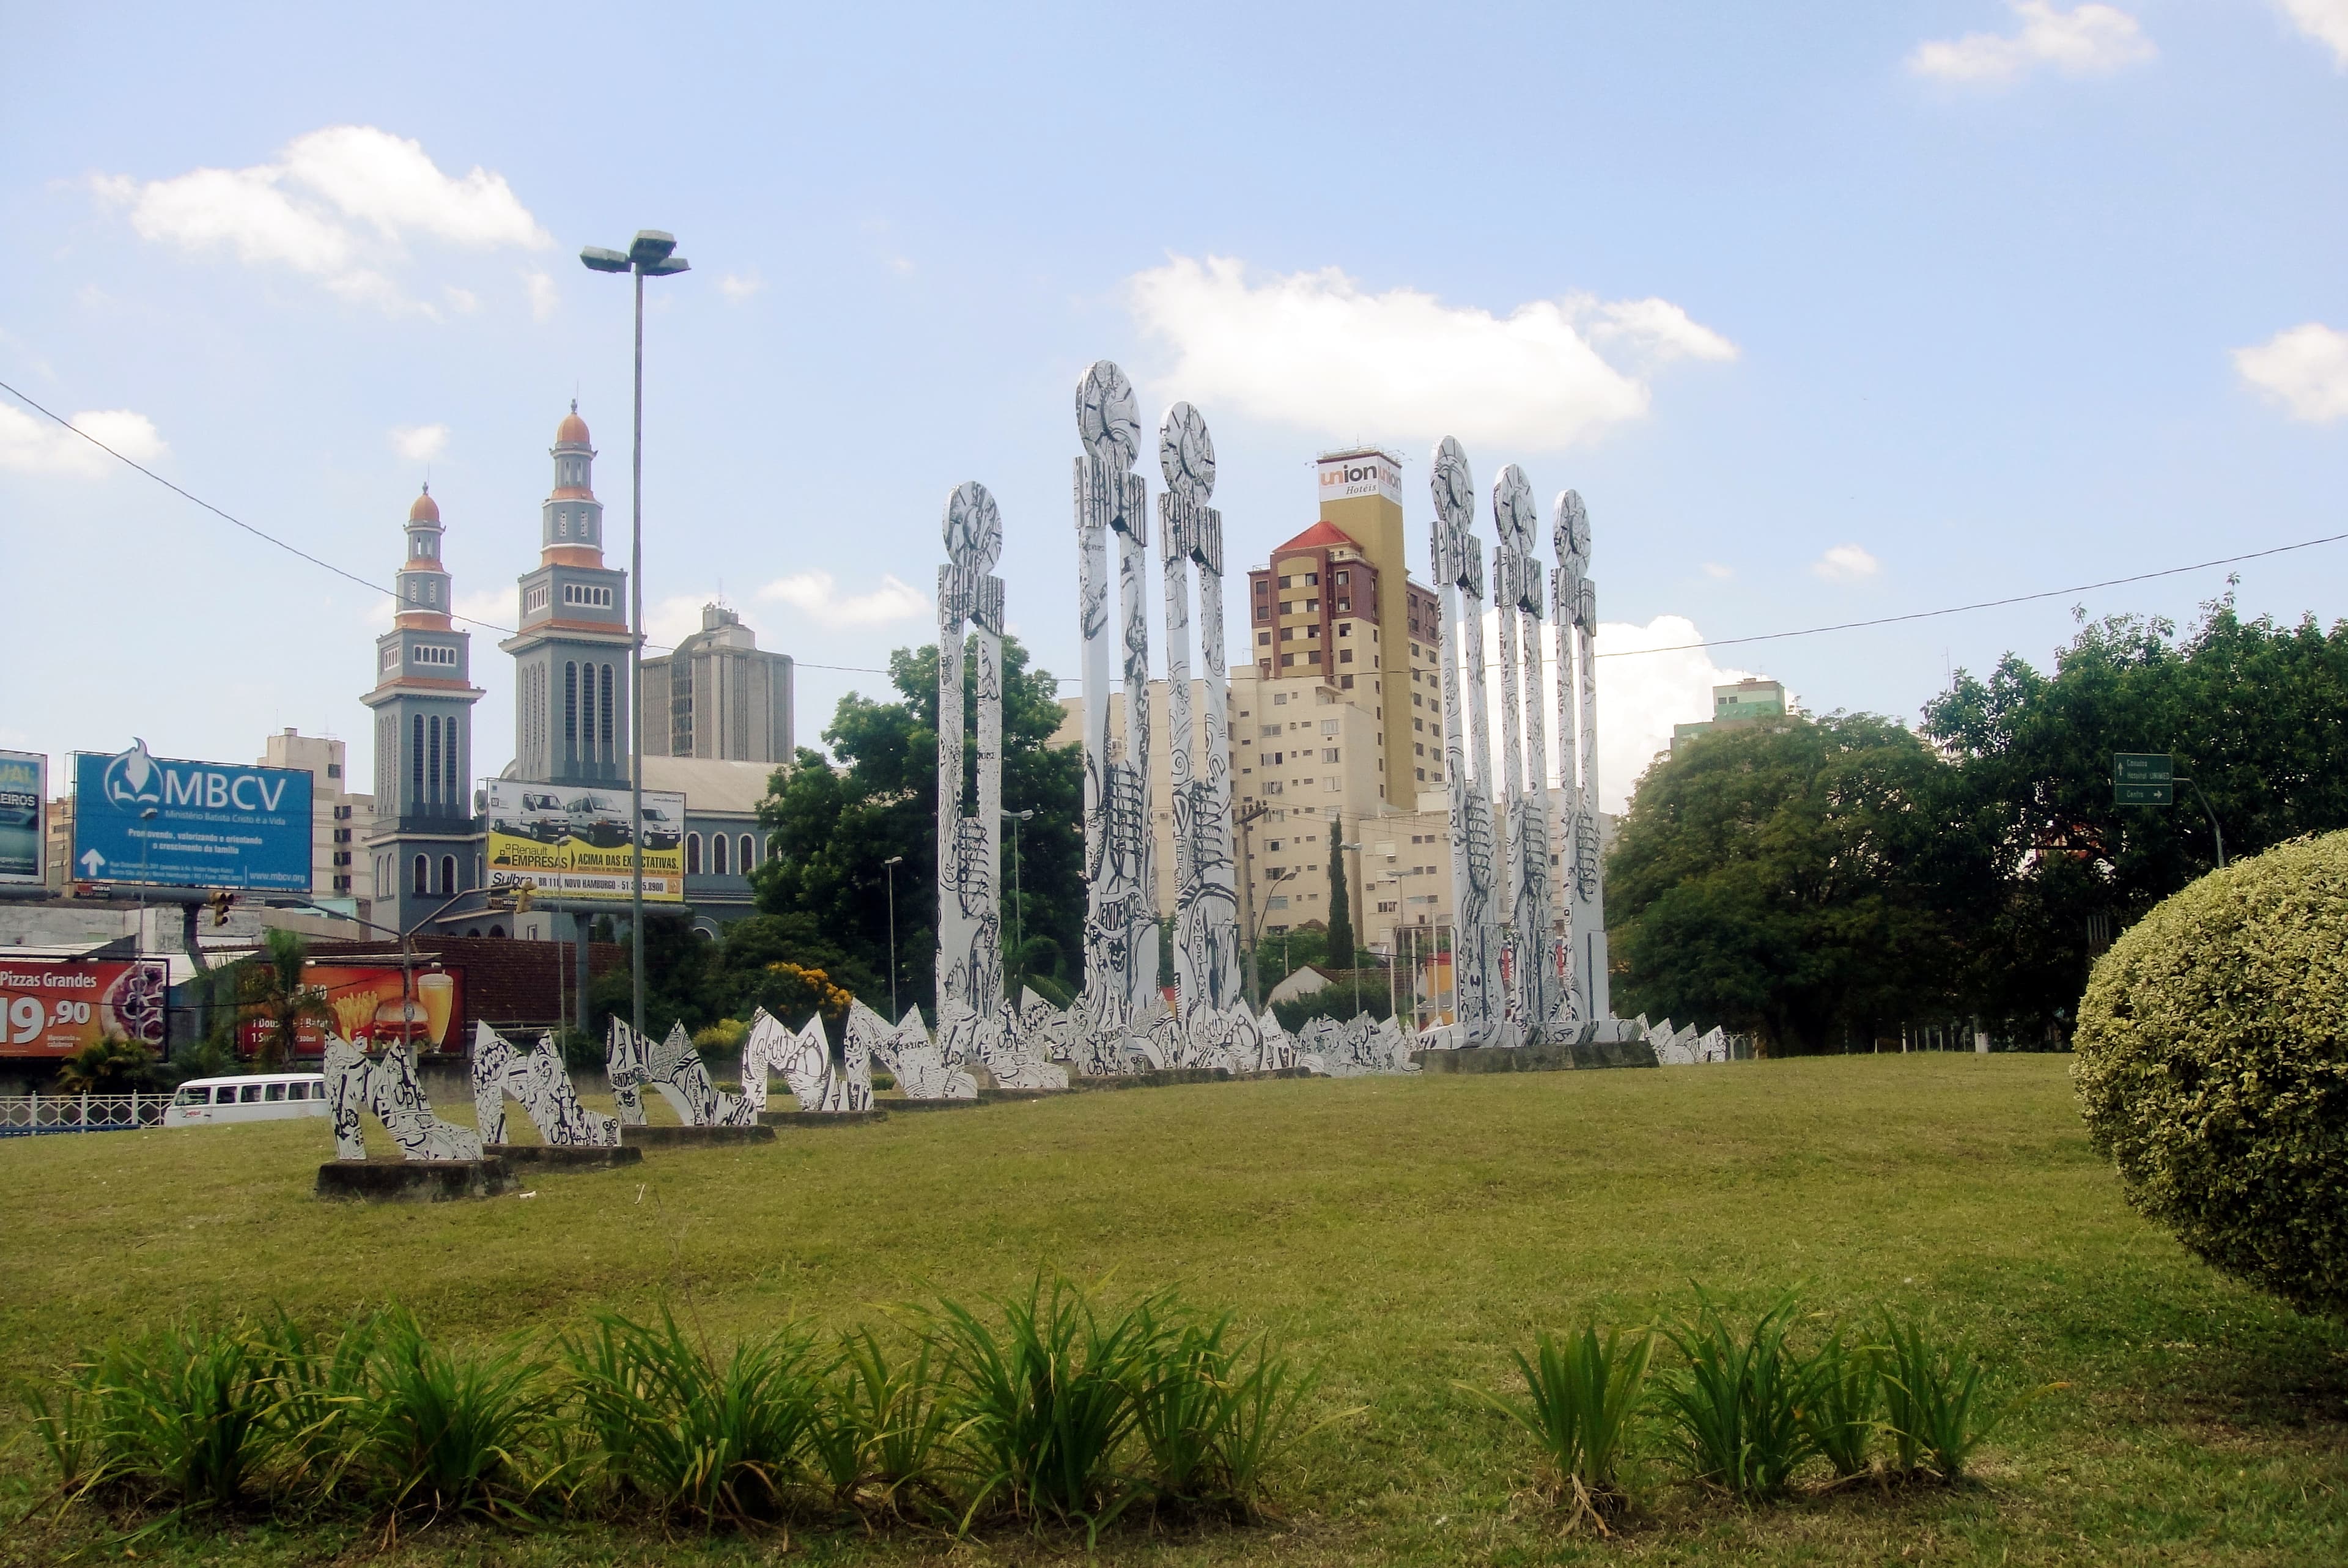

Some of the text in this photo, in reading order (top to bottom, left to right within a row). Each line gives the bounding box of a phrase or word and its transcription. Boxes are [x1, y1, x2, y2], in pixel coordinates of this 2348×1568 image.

[1320, 464, 1377, 486] union
[1379, 466, 1402, 491] union
[1346, 484, 1376, 495] Hotéis
[166, 769, 286, 811] MBCV
[166, 810, 203, 820] Ministério
[205, 812, 231, 822] Batista
[232, 814, 254, 823] Cristo
[268, 817, 286, 825] Vida
[177, 832, 218, 842] valorizando
[226, 834, 262, 844] orientando
[159, 842, 202, 852] crescimento
[512, 844, 548, 856] Renault
[512, 855, 567, 869] EMPRESAS
[578, 853, 603, 866] ACIMA
[606, 855, 621, 866] DAS
[623, 855, 679, 870] EXCTATIVAS.
[249, 872, 305, 884] www.mbcv.org
[539, 877, 547, 886] BR
[564, 878, 580, 888] NOVO
[583, 879, 616, 889] HAMBURGO
[622, 881, 629, 890] 51
[631, 881, 664, 892] 35.8900
[0, 970, 40, 987] Pizzas
[43, 972, 97, 988] Grandes
[897, 1040, 931, 1050] DESIGN
